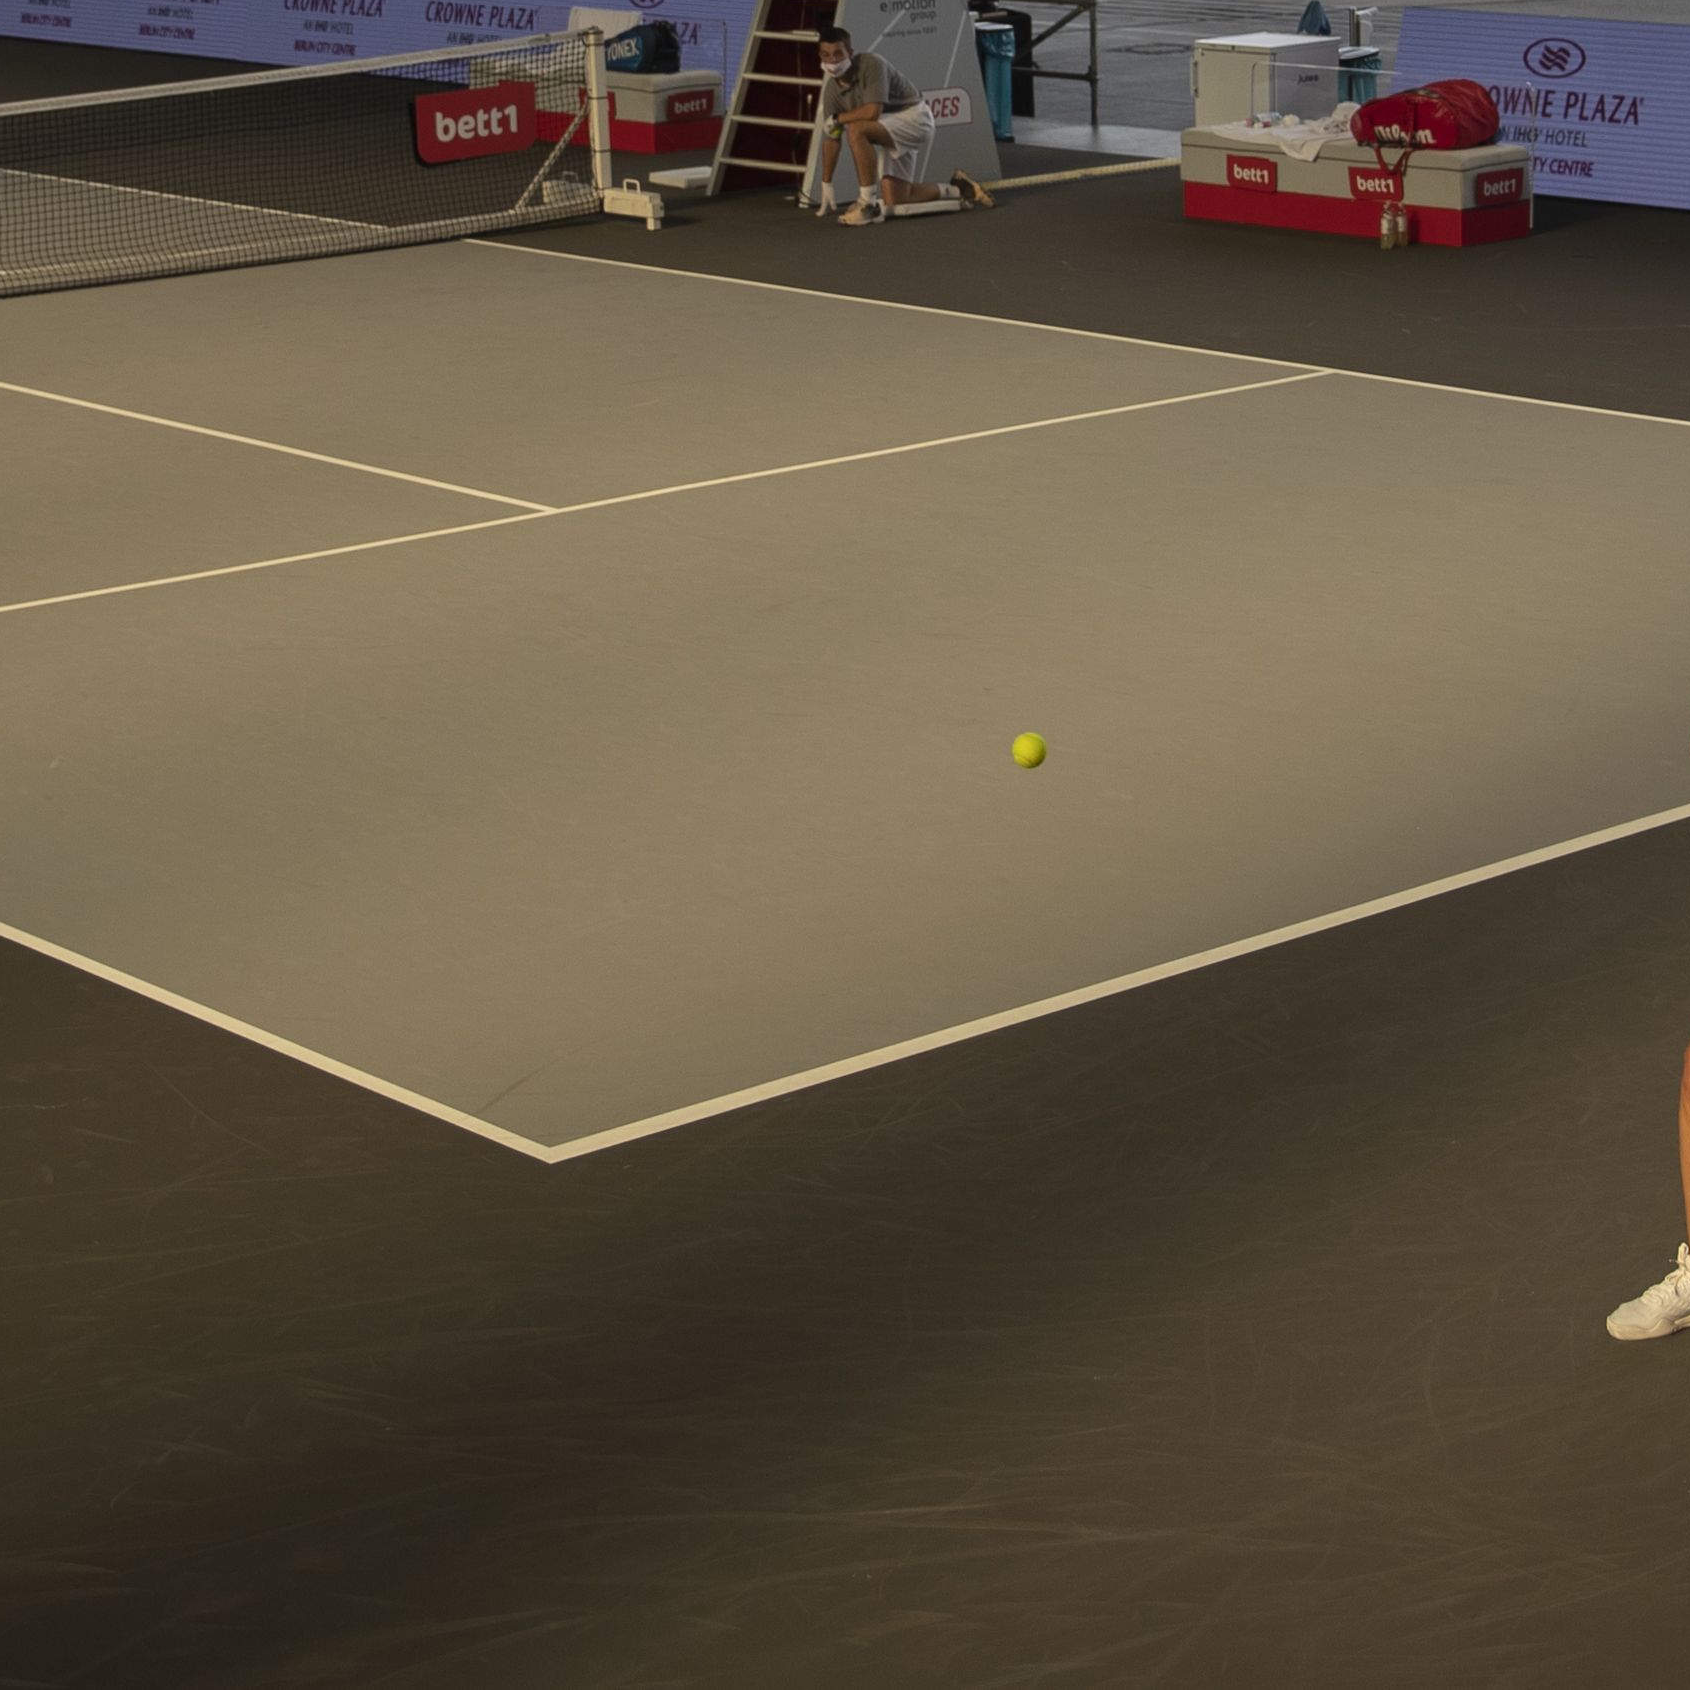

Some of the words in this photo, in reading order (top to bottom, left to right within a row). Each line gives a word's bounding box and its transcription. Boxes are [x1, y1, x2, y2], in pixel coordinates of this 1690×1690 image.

[426, 0, 485, 27] CROWNE
[488, 4, 534, 31] PLAZA
[909, 10, 938, 24] group
[673, 97, 708, 115] bett1
[925, 96, 960, 119] CES
[1487, 85, 1556, 118] OWNE
[1563, 91, 1640, 125] PLAZA
[434, 103, 519, 144] bett1
[1545, 128, 1589, 148] HOTEL
[1233, 163, 1270, 185] bett1
[1549, 159, 1595, 178] CENTRE
[1356, 174, 1395, 194] bett1
[1483, 177, 1517, 197] bett1
